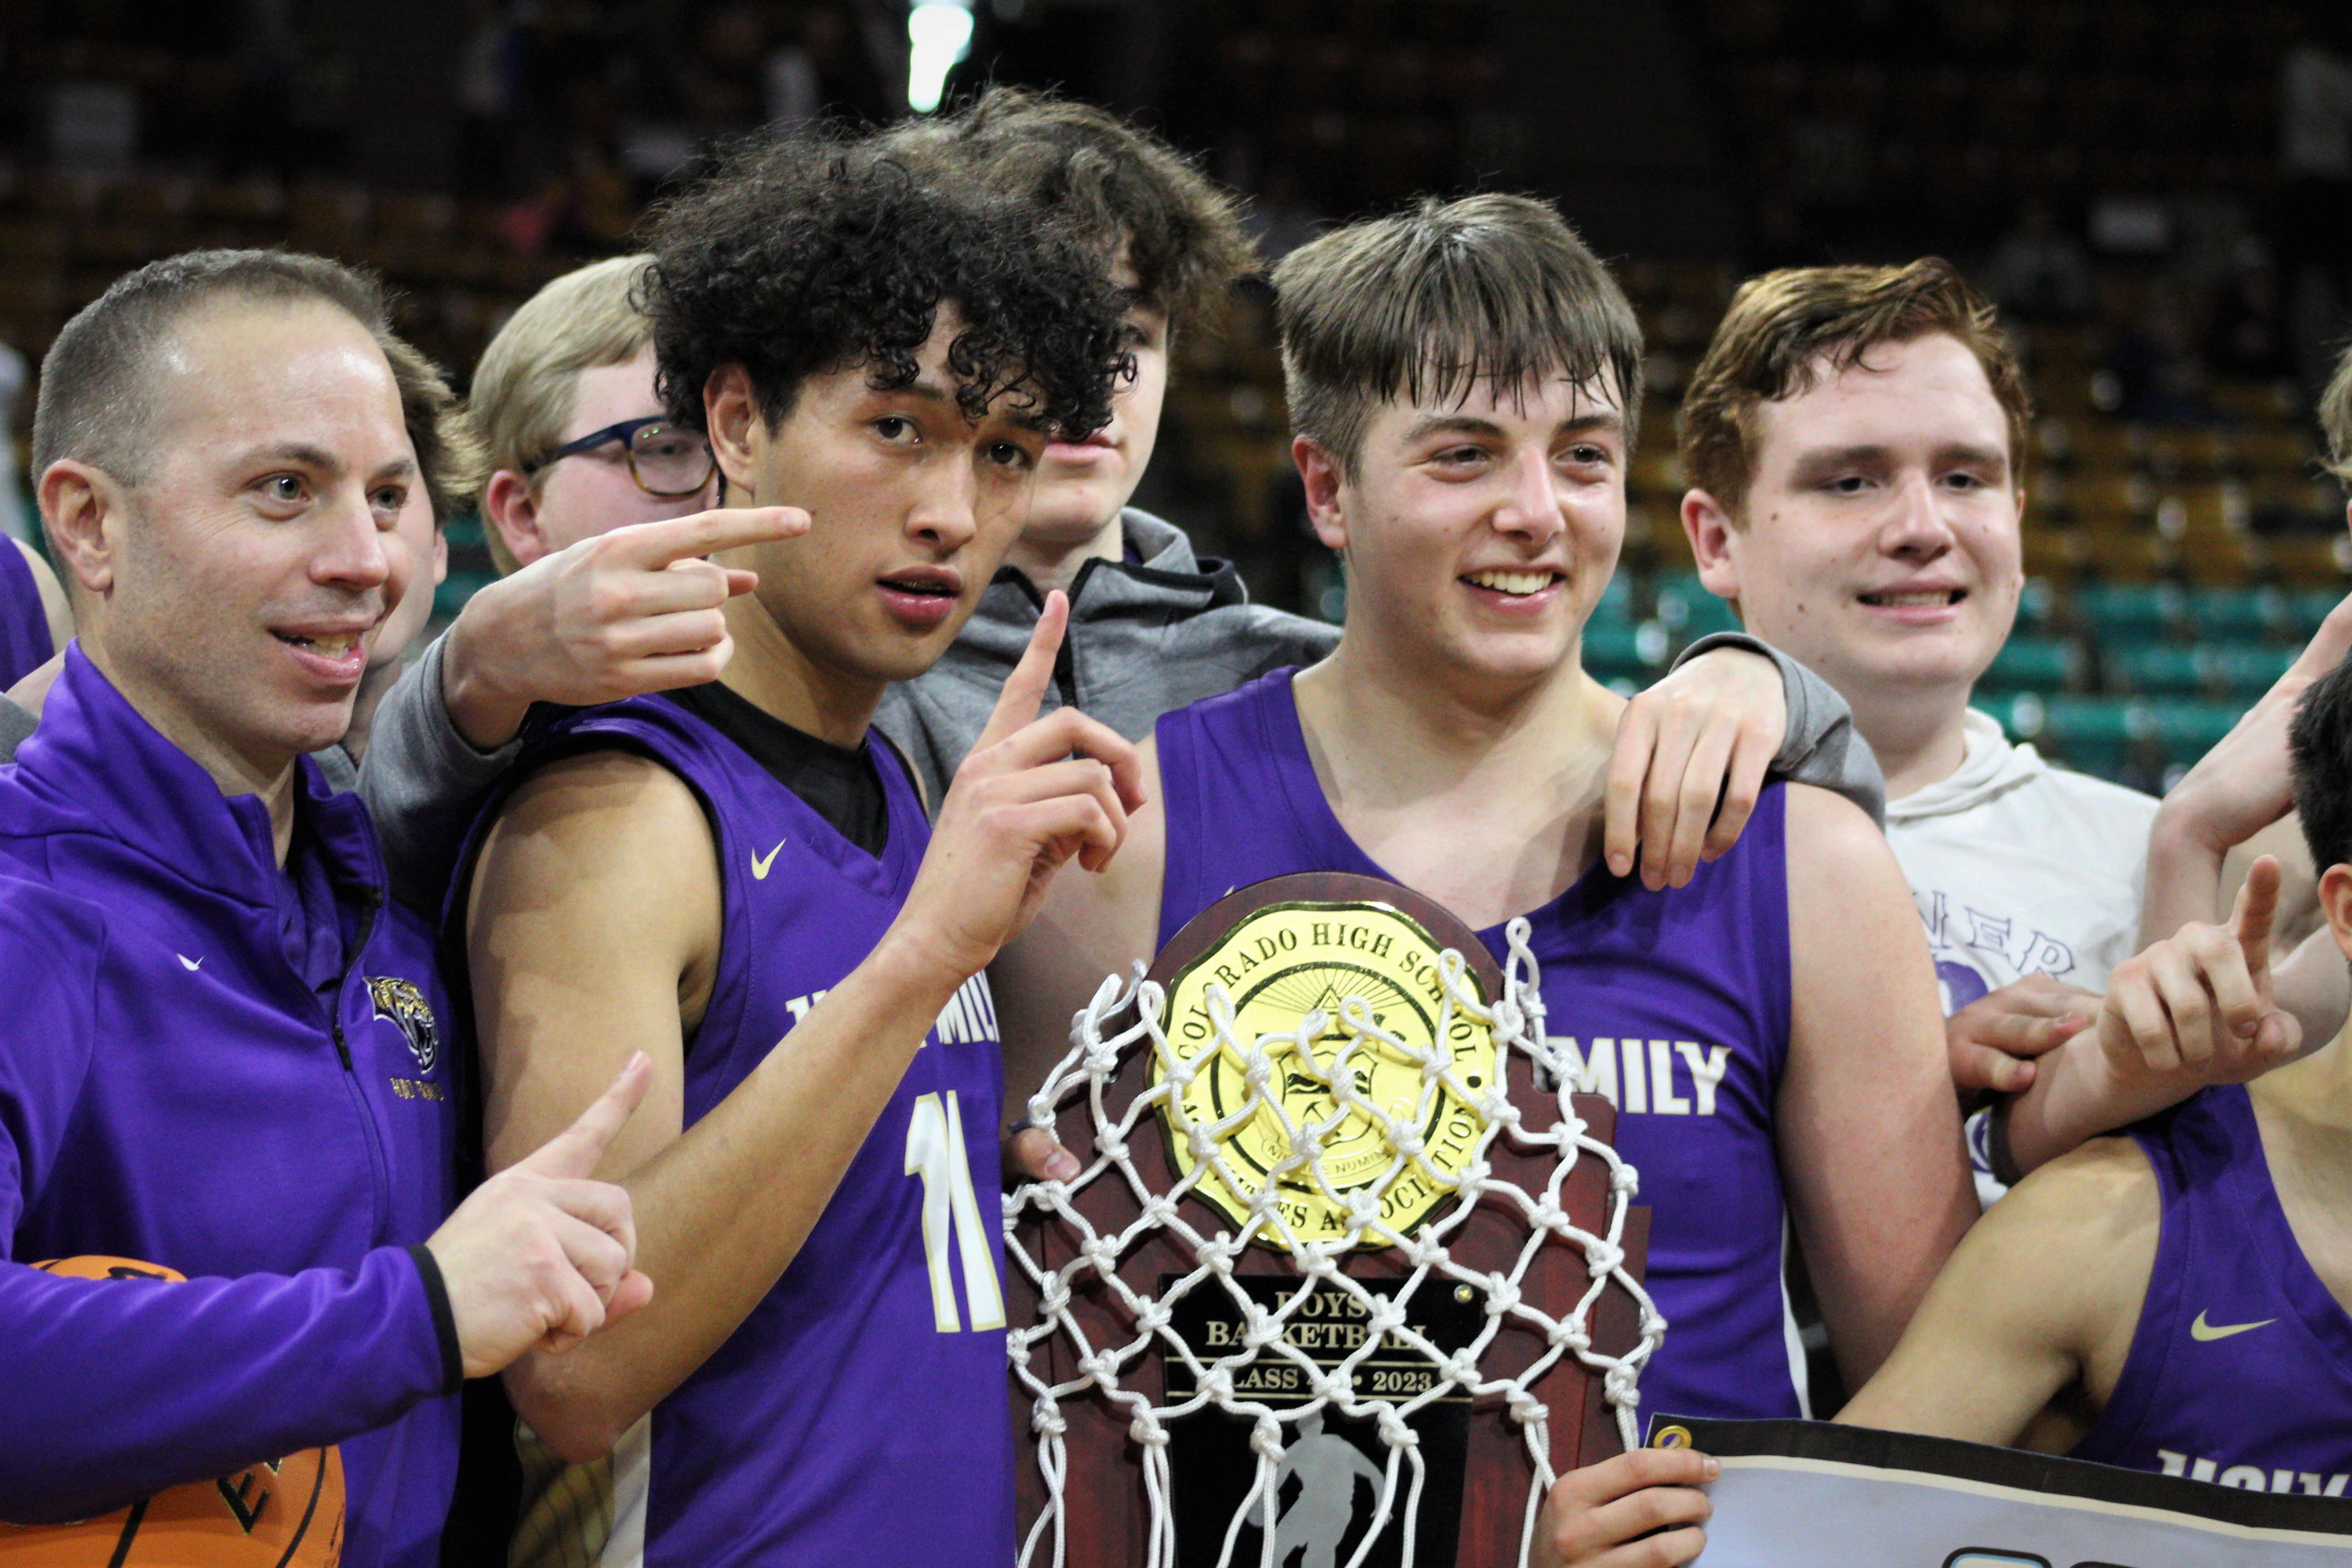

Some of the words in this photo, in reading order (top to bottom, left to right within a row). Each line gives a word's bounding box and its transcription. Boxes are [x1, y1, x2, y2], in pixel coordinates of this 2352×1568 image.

[1178, 928, 1297, 1060] COLRADO
[1311, 922, 1395, 959] HIGH
[1398, 951, 1477, 1062] SCHOL
[904, 1090, 1006, 1333] 11
[1319, 1107, 1475, 1231] AOCITIO
[1205, 1320, 1436, 1350] BAKETBLL
[1230, 1366, 1298, 1390] LASS
[1372, 1371, 1432, 1392] 2023
